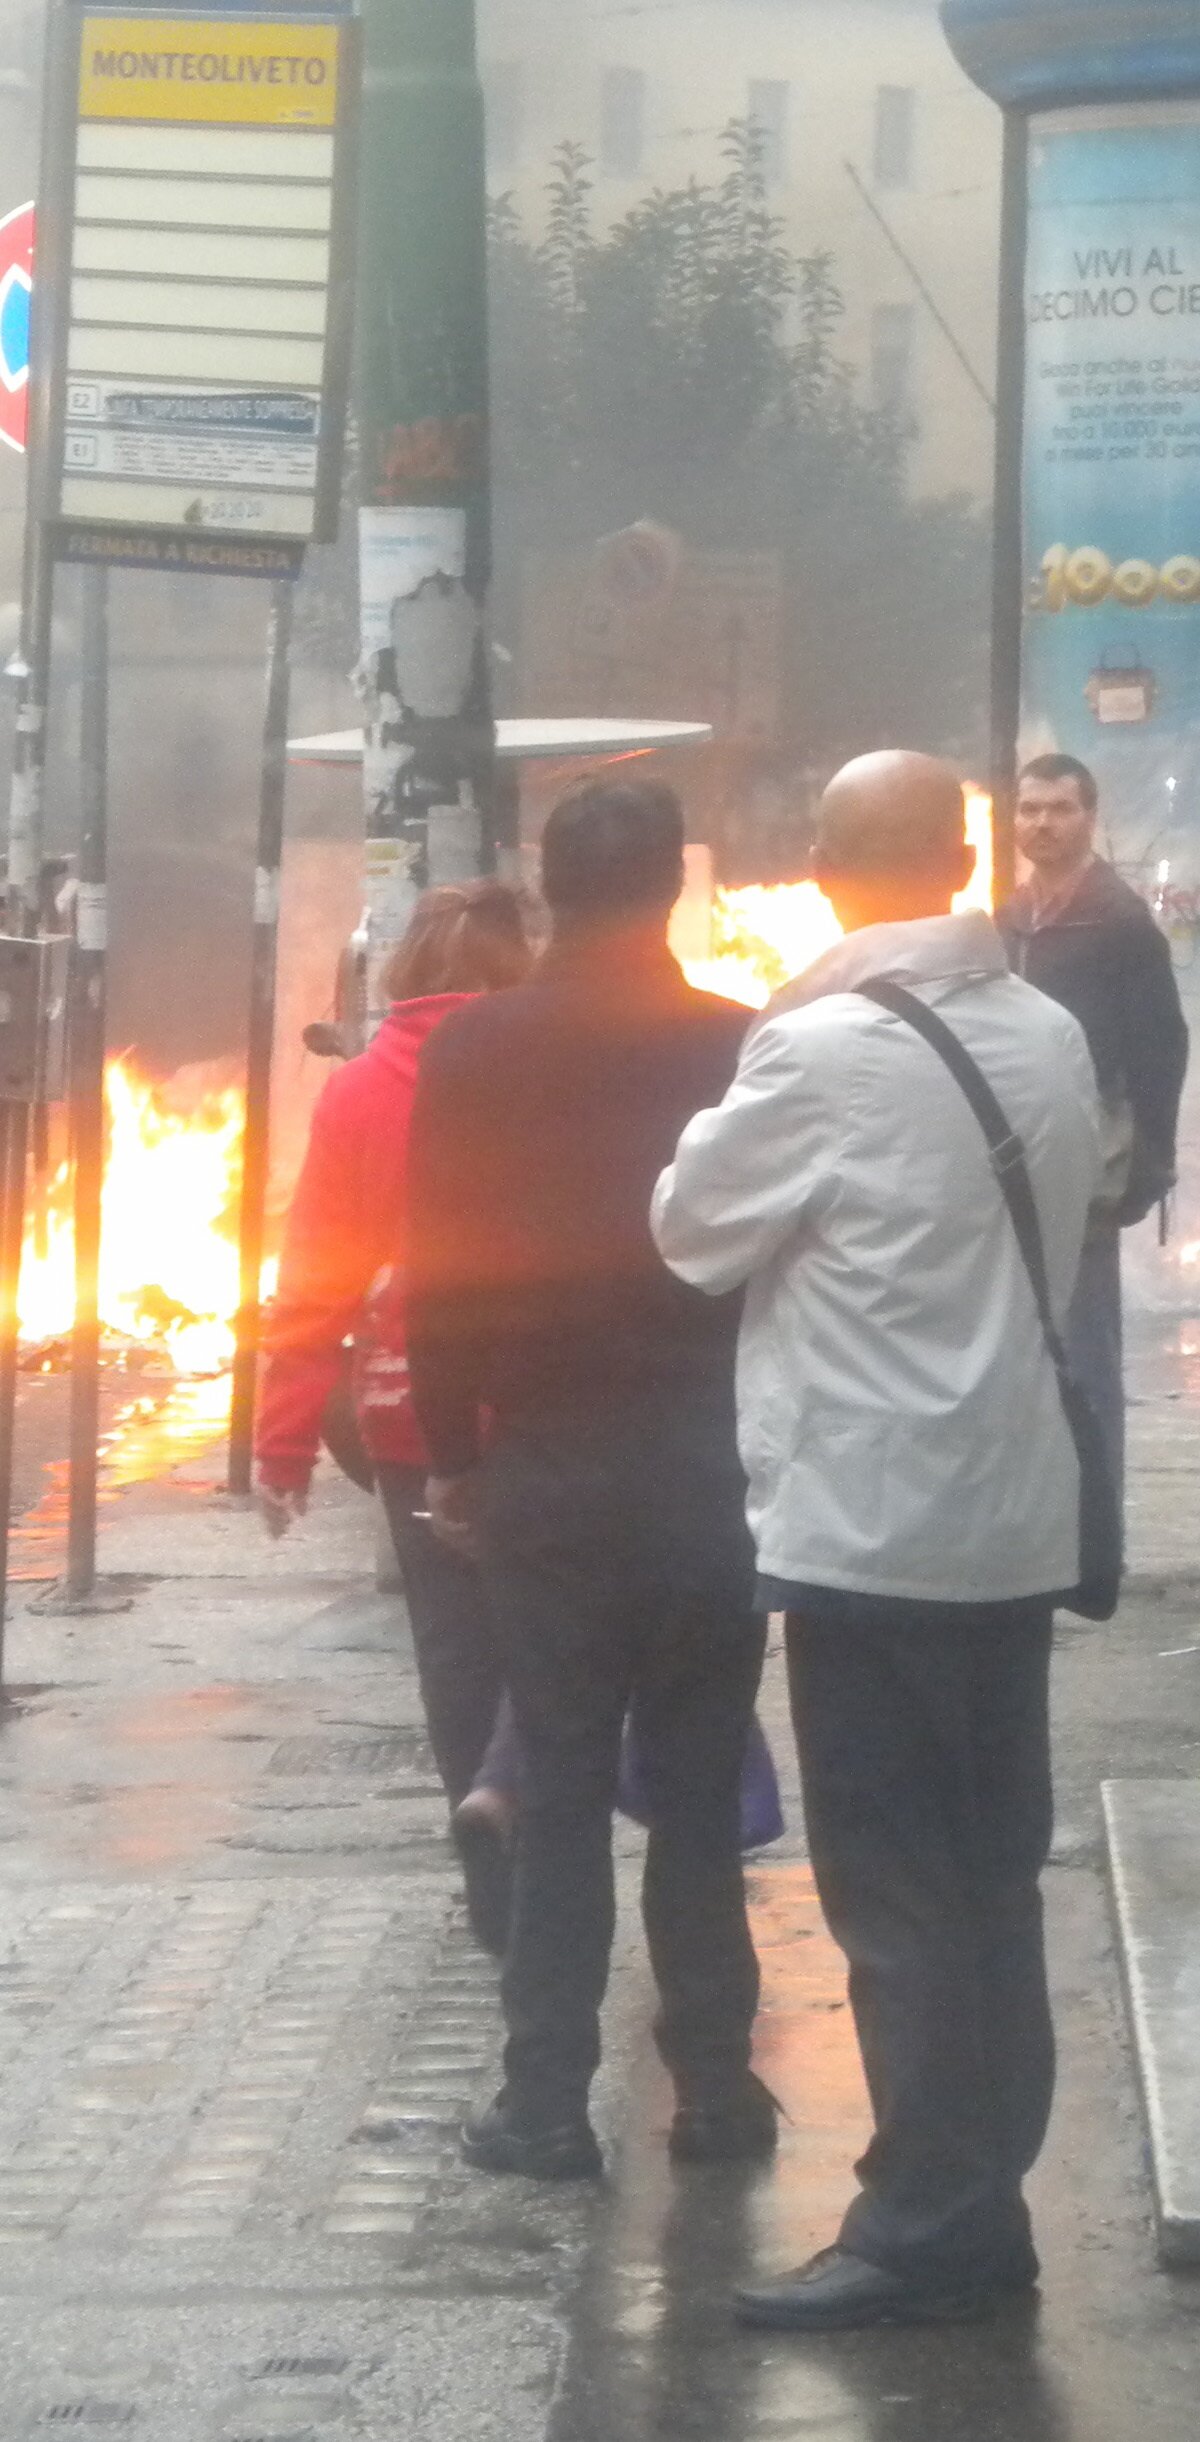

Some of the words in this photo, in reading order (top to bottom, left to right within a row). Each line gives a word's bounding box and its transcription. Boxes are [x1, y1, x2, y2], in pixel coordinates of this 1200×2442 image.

[92, 50, 326, 85] MONTEOLIVETO
[1074, 248, 1132, 279] VIVI
[1144, 247, 1183, 276] AL
[1031, 286, 1138, 322] DECIMO
[1084, 358, 1142, 375] anche
[1146, 356, 1167, 373] al
[1085, 379, 1110, 397] For
[1108, 445, 1139, 462] per
[68, 534, 160, 560] FERMATA
[164, 543, 181, 562] A
[186, 544, 292, 571] RICHIESTA
